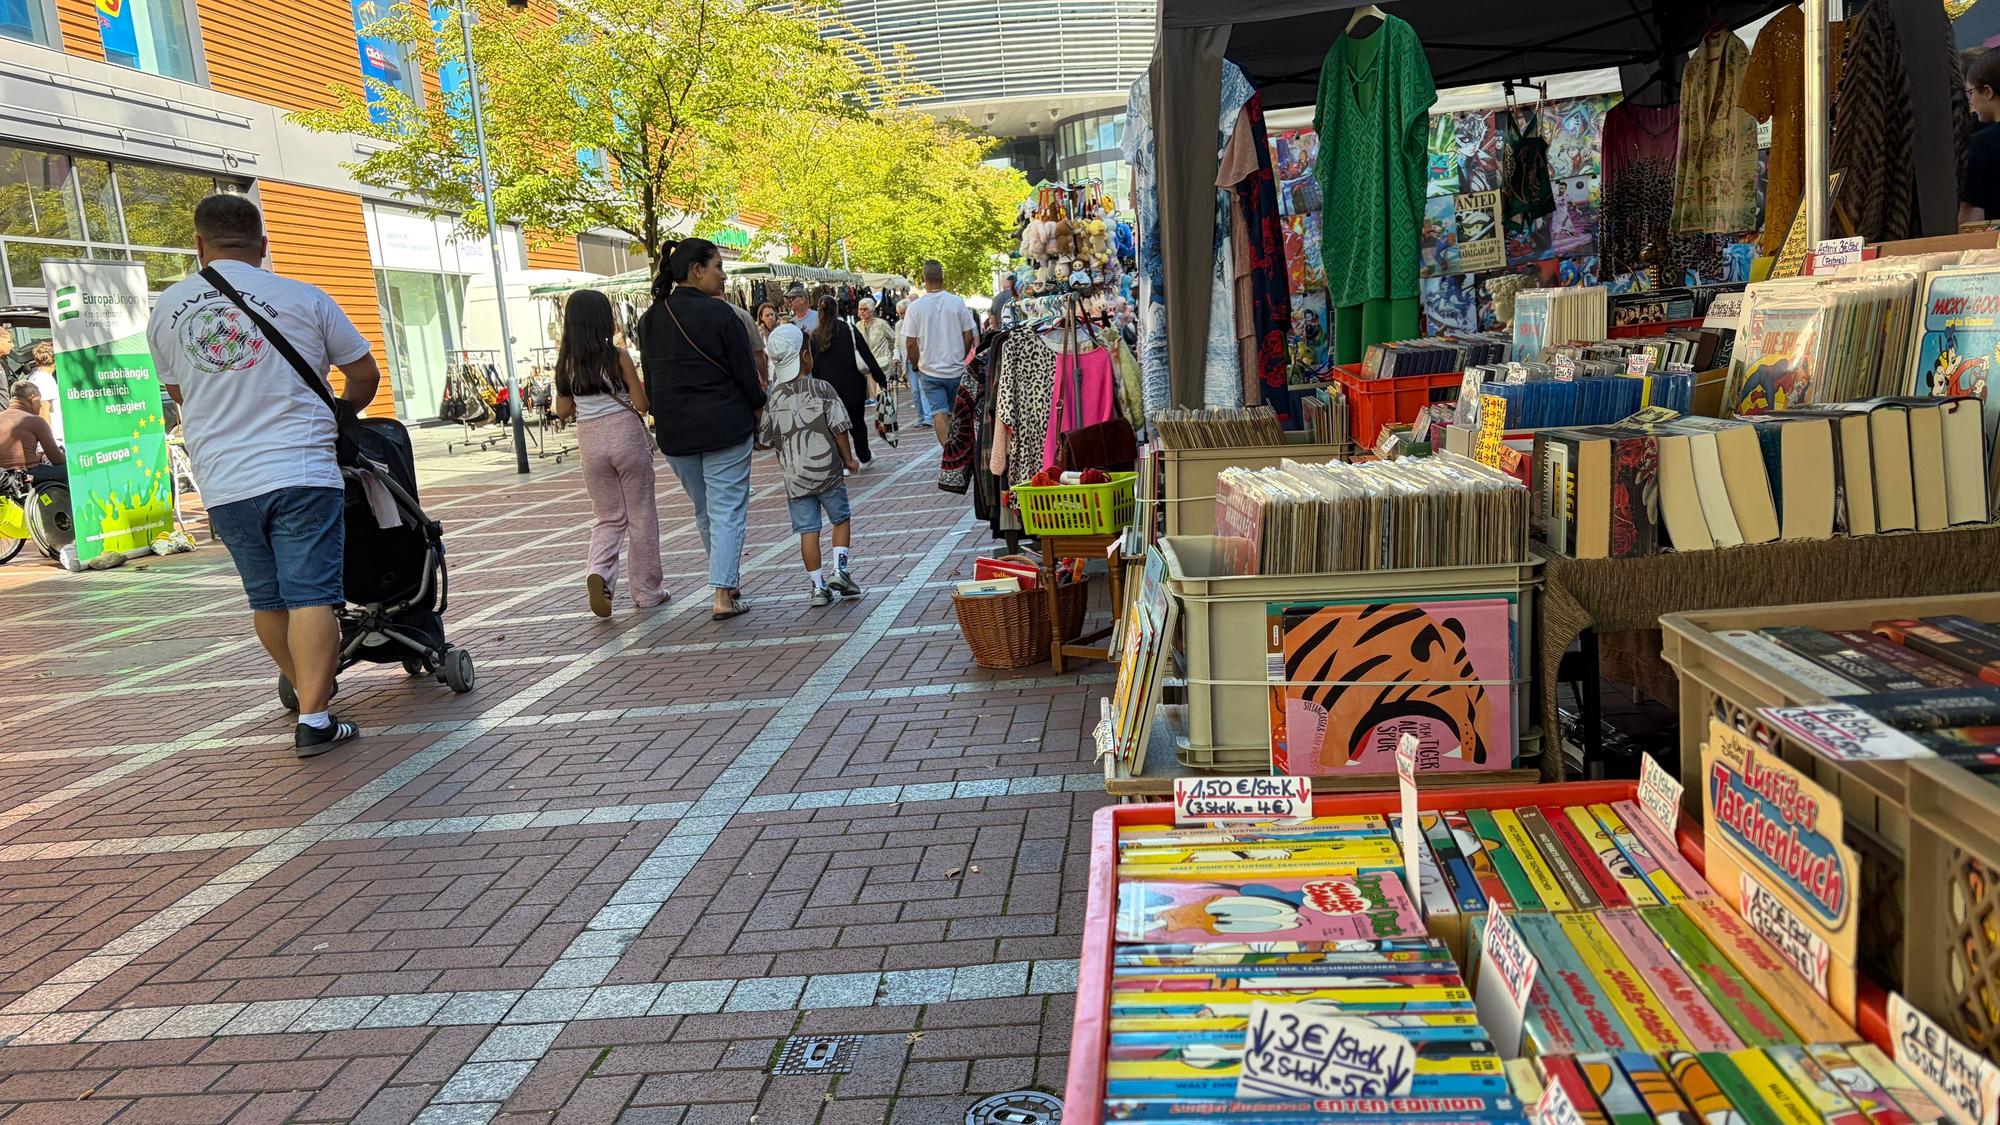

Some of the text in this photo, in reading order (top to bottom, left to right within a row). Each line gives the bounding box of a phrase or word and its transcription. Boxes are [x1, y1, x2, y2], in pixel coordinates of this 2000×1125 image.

[1455, 193, 1496, 210] ANTED
[170, 290, 279, 329] JUVETUS
[98, 367, 149, 380] unabhängig
[67, 384, 130, 400] überparteilich
[105, 400, 146, 414] engagiert
[79, 448, 130, 468] für Europa
[1376, 725, 1397, 753] SPUR
[1420, 722, 1440, 770] DEM TIGER
[1188, 778, 1232, 799] 1,50
[1743, 747, 1817, 833] Lustiges
[1713, 762, 1842, 913] Taschenbuch
[1557, 970, 1625, 1047] JUMBO-COMICS
[1603, 968, 1679, 1044] JUMBO-COMICS
